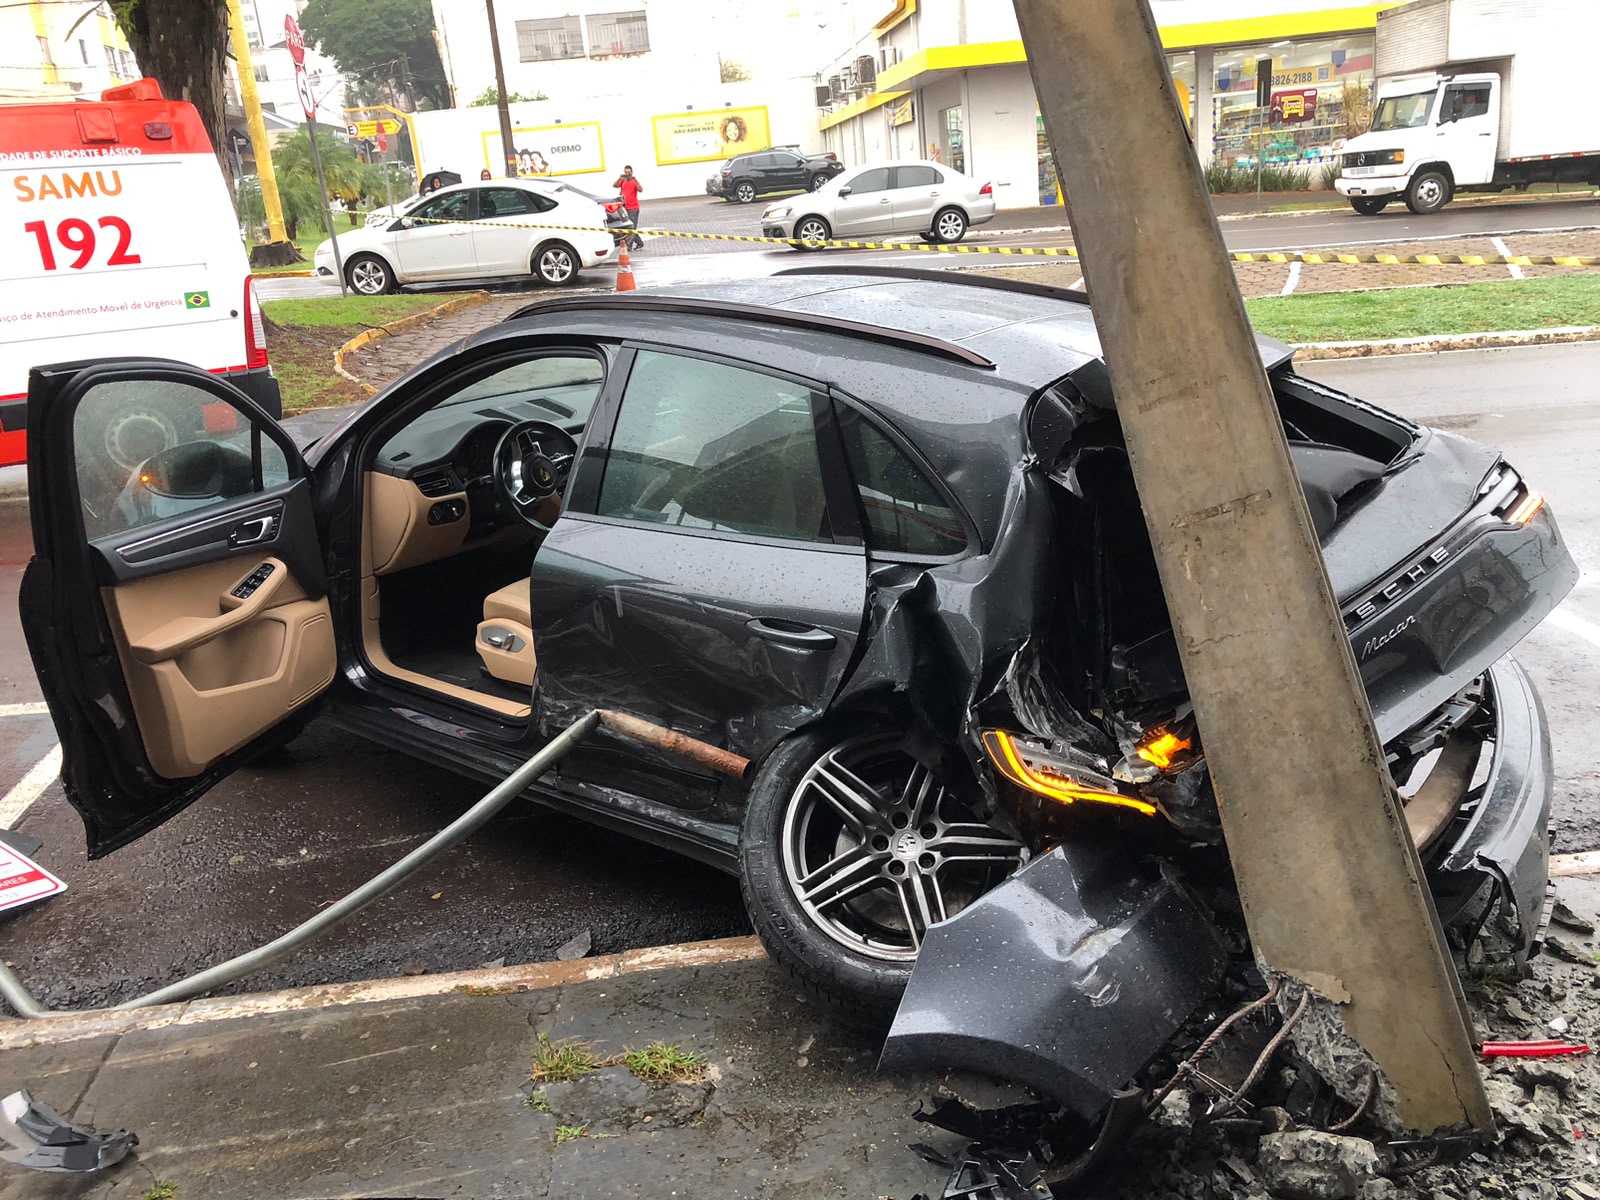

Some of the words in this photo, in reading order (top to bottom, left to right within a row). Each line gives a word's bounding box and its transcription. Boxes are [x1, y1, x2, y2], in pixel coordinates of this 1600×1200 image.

[285, 29, 304, 49] PARE
[347, 125, 355, 135] E
[33, 150, 48, 159] DE
[50, 148, 100, 159] SUPORTE
[101, 145, 141, 157] BÁSICO
[550, 144, 582, 154] DERMO
[14, 170, 122, 202] SAMU
[24, 216, 142, 271] 192
[21, 312, 32, 320] de
[36, 305, 98, 319] Atendimento
[100, 302, 128, 314] Móvel
[131, 301, 142, 310] de
[144, 298, 183, 310] Urgência
[1361, 614, 1417, 660] Macan
